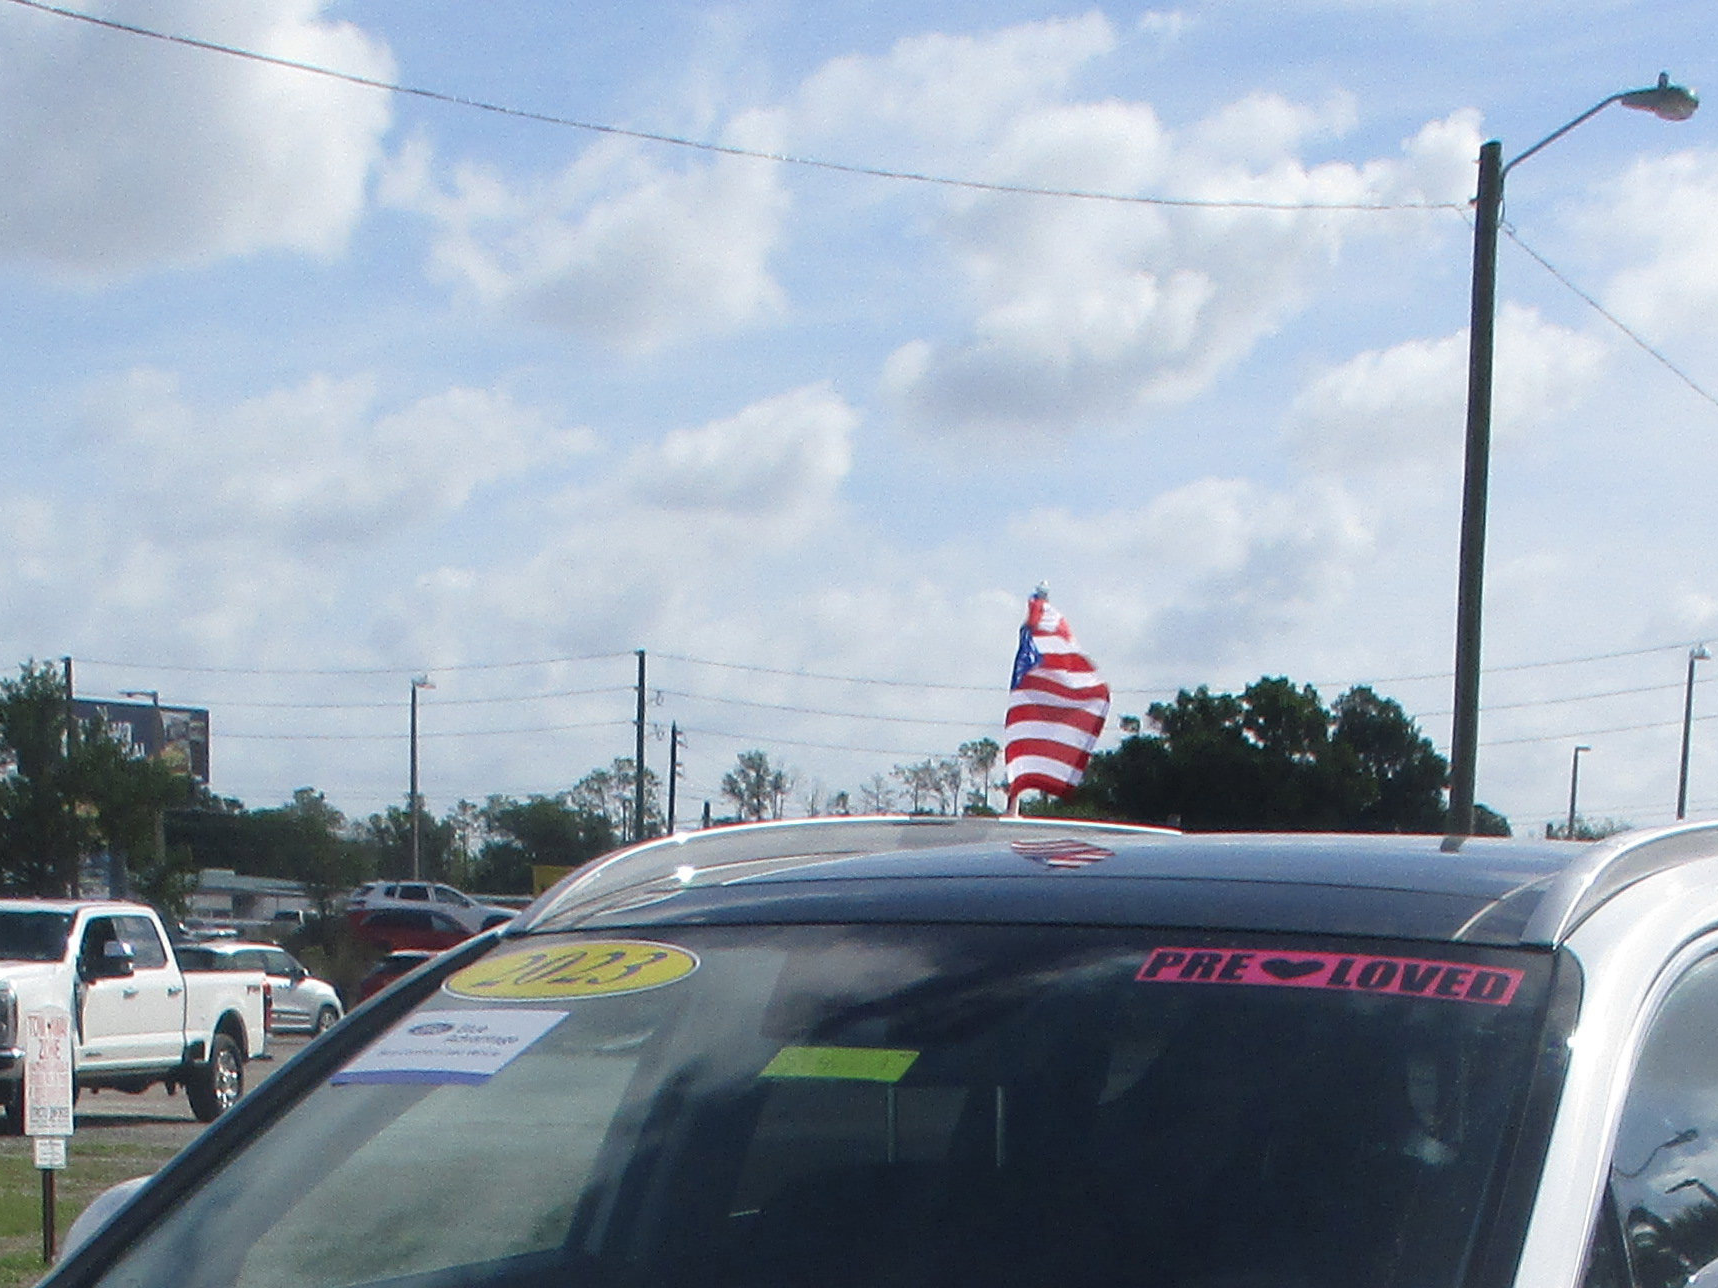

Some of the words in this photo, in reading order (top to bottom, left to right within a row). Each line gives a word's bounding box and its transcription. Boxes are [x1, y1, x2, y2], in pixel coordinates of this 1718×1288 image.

[468, 951, 669, 989] 2023
[1142, 950, 1255, 982] PRE
[1326, 957, 1511, 1001] LOVED
